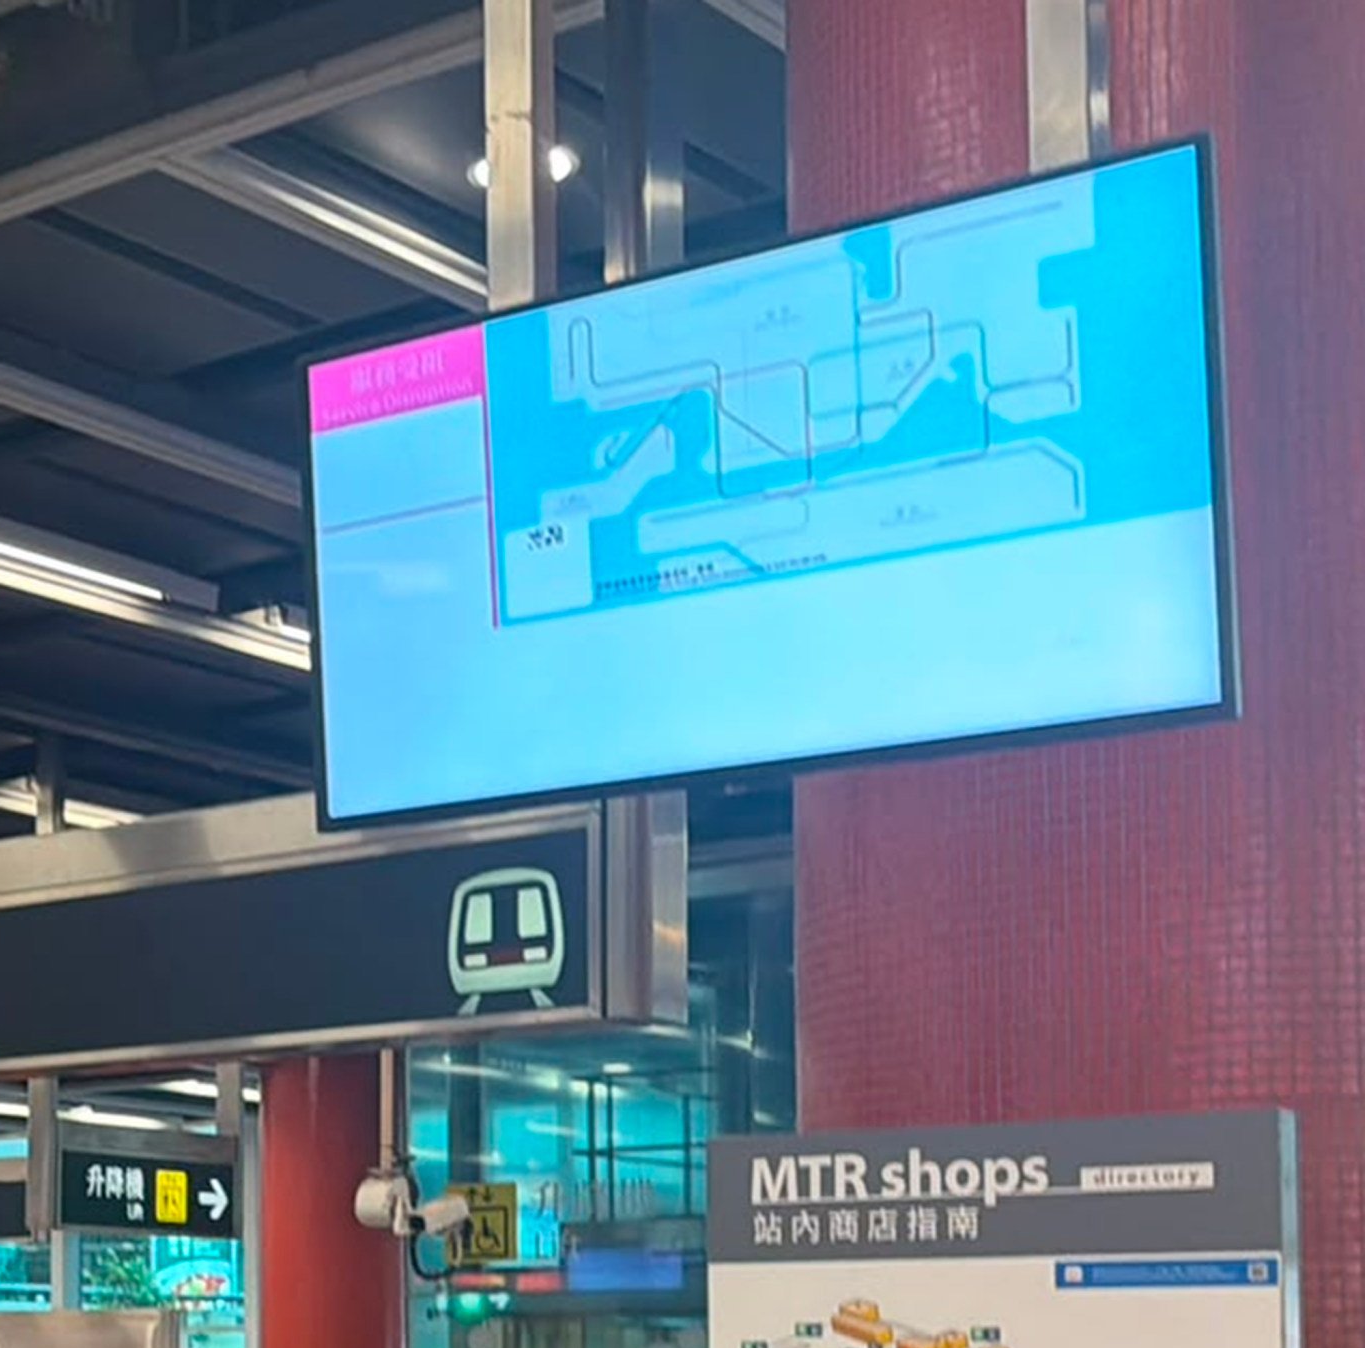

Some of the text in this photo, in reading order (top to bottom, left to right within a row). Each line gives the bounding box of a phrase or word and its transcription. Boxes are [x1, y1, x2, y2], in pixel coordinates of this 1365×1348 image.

[86, 1163, 144, 1200] 升降機
[750, 1147, 1049, 1208] MTR shops
[1094, 1167, 1200, 1188] directory
